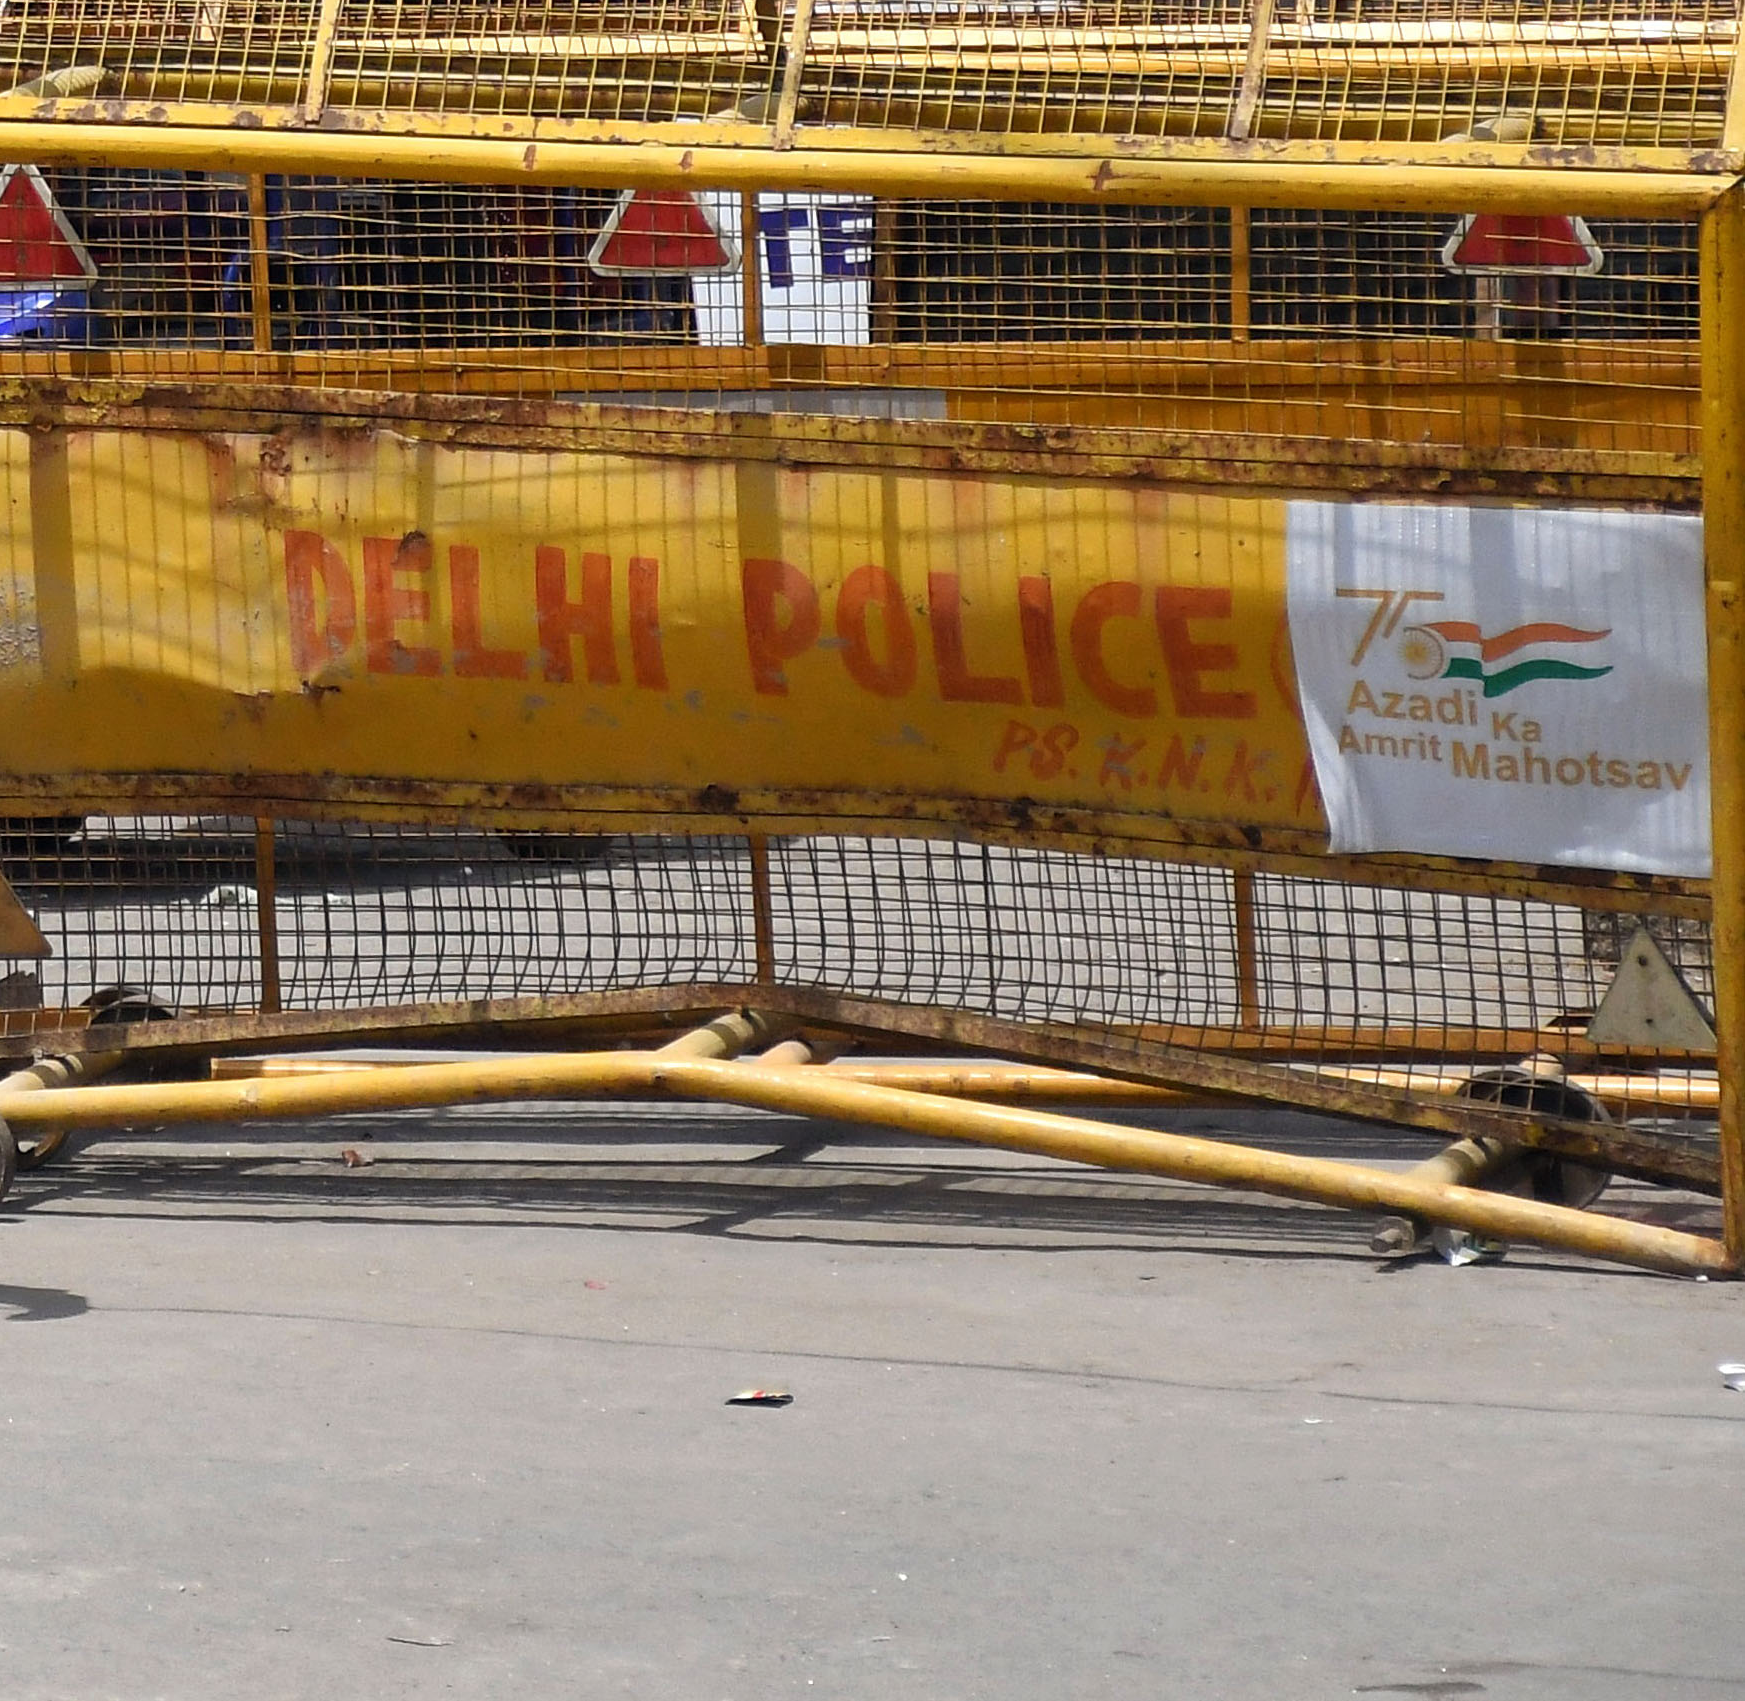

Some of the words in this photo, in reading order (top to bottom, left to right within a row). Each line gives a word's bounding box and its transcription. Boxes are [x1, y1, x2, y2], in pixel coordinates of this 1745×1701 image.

[284, 529, 670, 693] DELHI
[741, 558, 1259, 719] POLICE
[1346, 678, 1479, 727] Azadi
[1491, 711, 1543, 744] Ka
[1338, 723, 1443, 762] Amrit
[1450, 740, 1693, 791] Mahotsav
